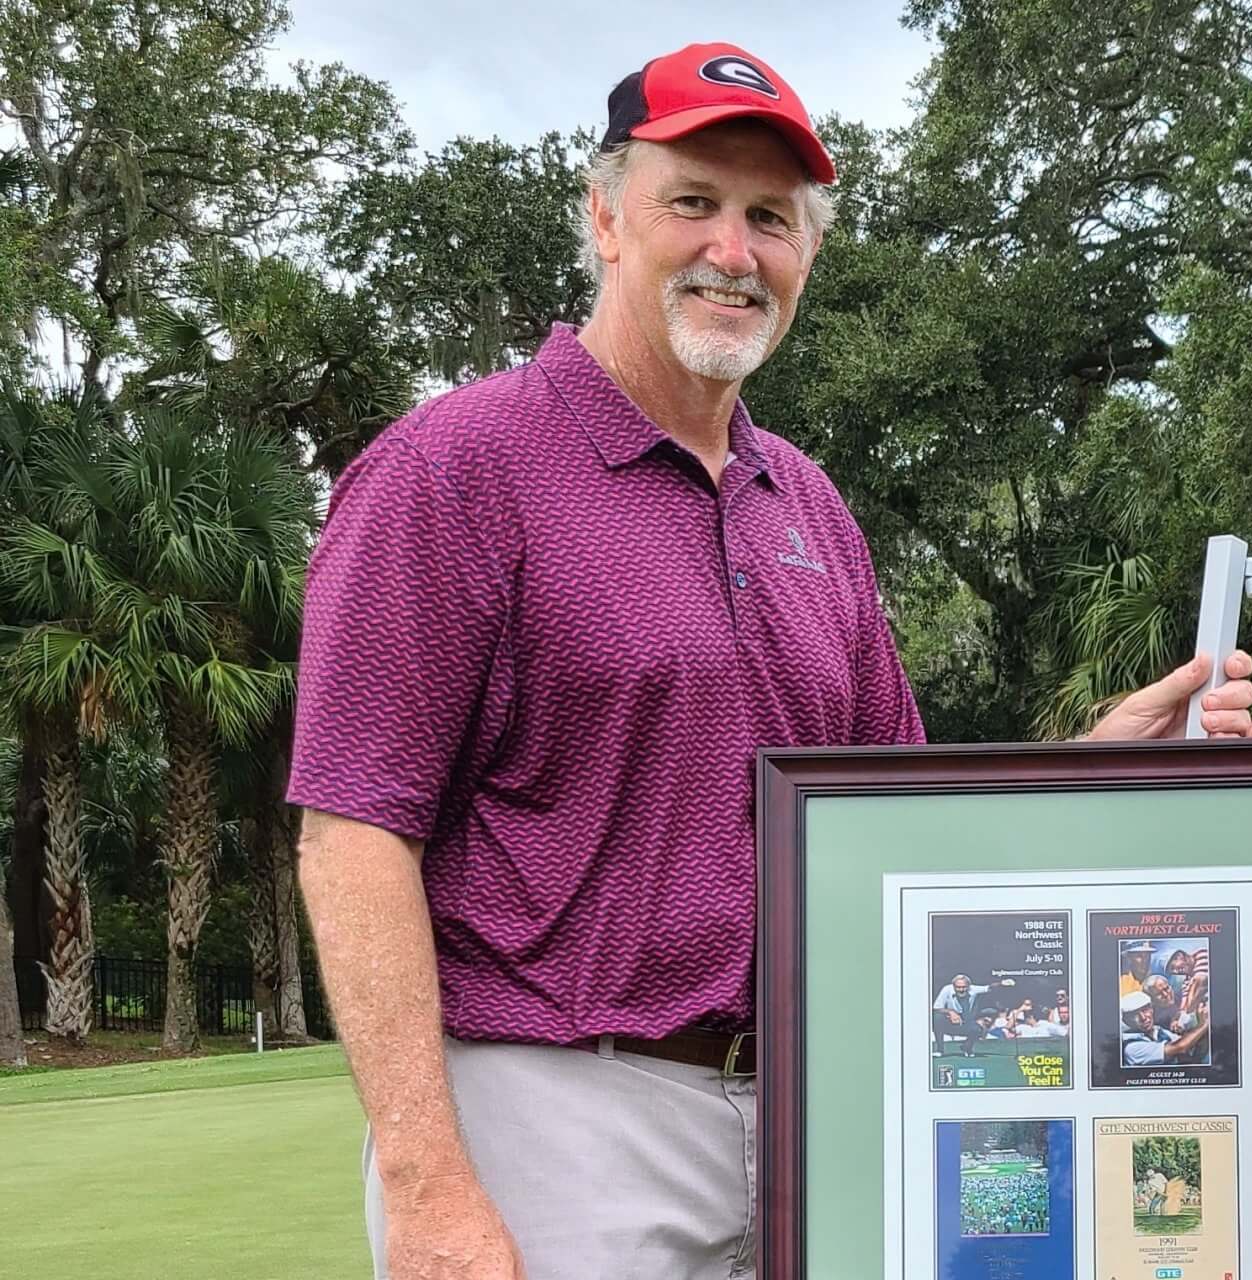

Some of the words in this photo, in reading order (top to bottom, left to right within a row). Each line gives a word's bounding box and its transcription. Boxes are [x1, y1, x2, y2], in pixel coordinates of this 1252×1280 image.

[1141, 915, 1160, 924] 1989
[1164, 915, 1185, 923] GTE
[1046, 921, 1063, 929] GTE
[1105, 925, 1174, 935] NORTHWEST
[1177, 924, 1222, 933] CLASSIC
[1015, 931, 1062, 939] Northwest
[1025, 955, 1043, 963] July
[1018, 1056, 1031, 1064] So
[1033, 1056, 1062, 1065] Close
[958, 1070, 984, 1078] GTE
[1022, 1066, 1041, 1075] You
[1043, 1066, 1063, 1074] Can
[1029, 1076, 1050, 1085] Feel
[1100, 1124, 1121, 1133] GTE
[1123, 1122, 1188, 1132] NORTHWEST
[1191, 1122, 1232, 1131] CLASSIC
[1160, 1238, 1176, 1246] 1991
[1158, 1270, 1181, 1278] GTE
